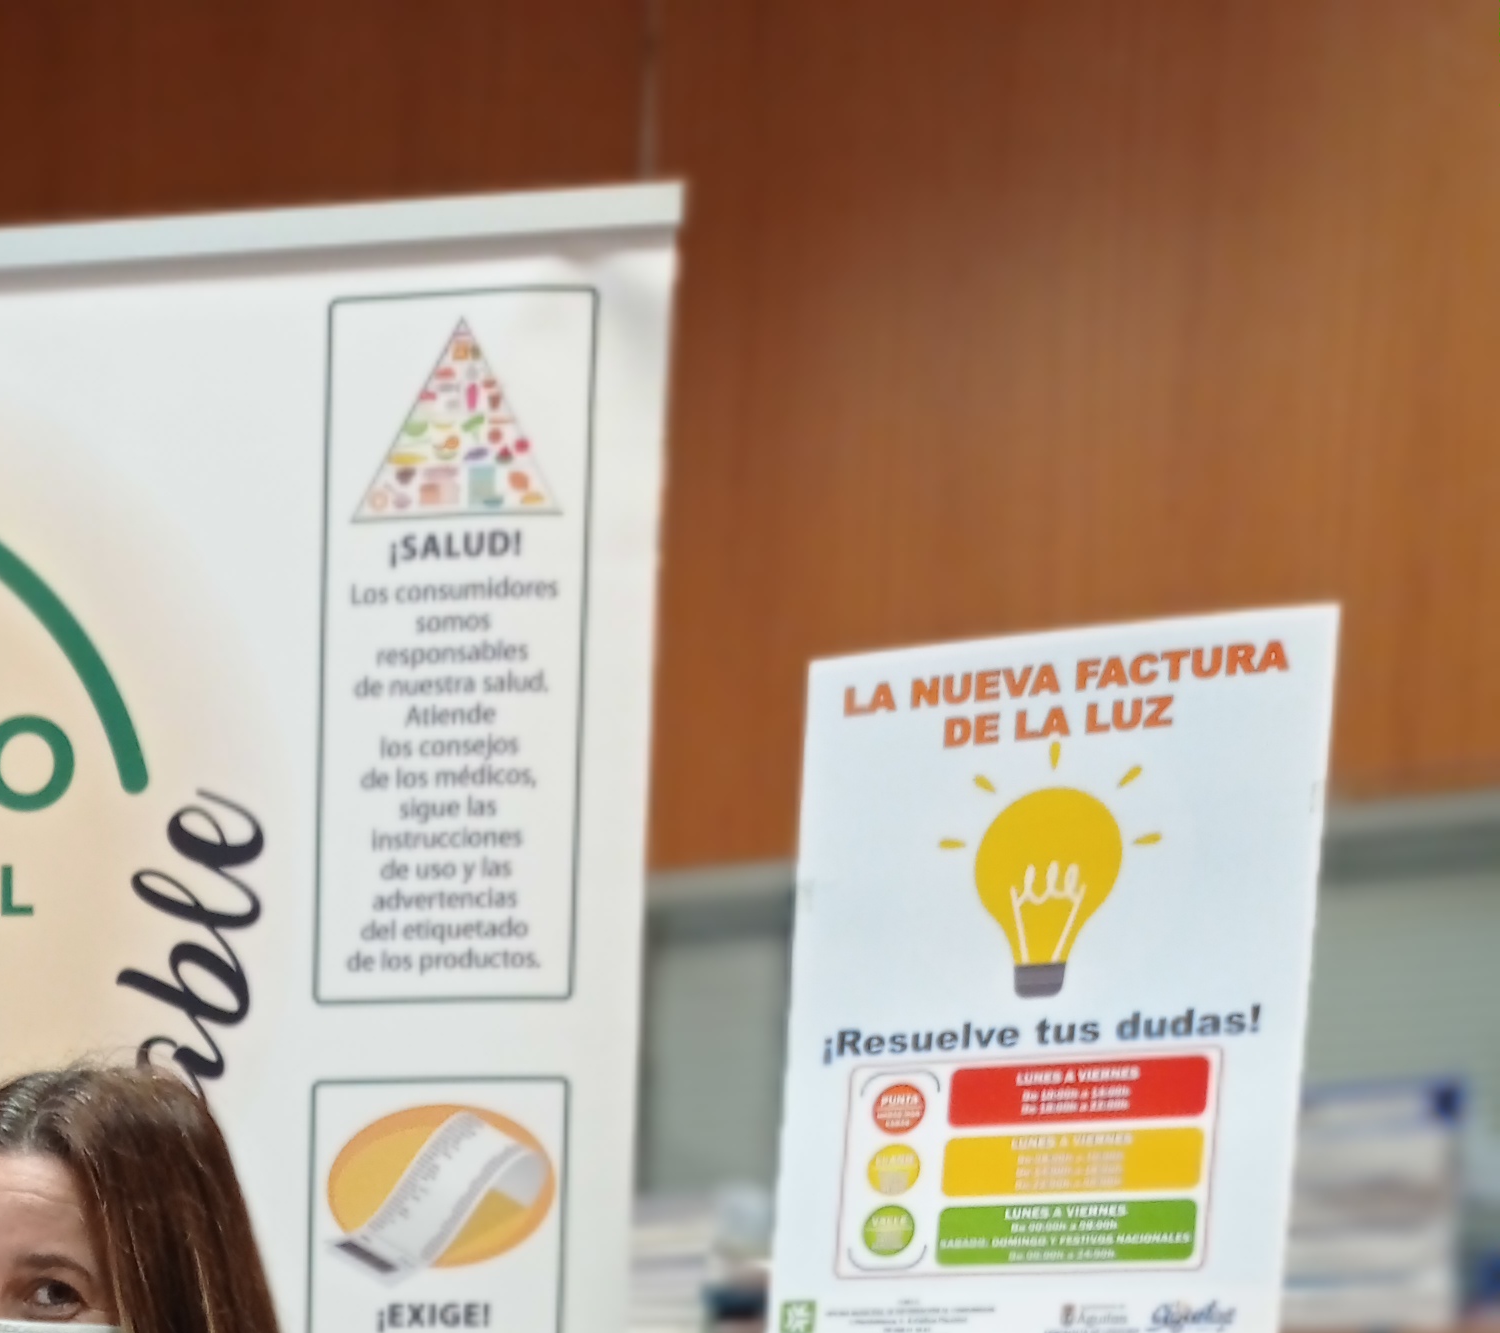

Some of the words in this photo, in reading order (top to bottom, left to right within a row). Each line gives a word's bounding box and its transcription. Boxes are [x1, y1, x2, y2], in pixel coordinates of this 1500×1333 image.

[390, 529, 521, 568] ¡SALUD!
[350, 584, 389, 606] Los
[394, 576, 559, 604] consumidores
[416, 613, 491, 633] somos
[376, 640, 529, 669] responsables
[354, 676, 383, 698] de
[388, 676, 476, 696] nuestra
[483, 670, 548, 693] salud.
[844, 682, 896, 716] LA
[911, 663, 1060, 708] NUEVA
[1076, 640, 1289, 691] FACTURA
[405, 703, 496, 726] Atiende
[944, 713, 1000, 748] DE
[1015, 706, 1070, 741] LA
[1085, 695, 1174, 734] LUZ
[380, 737, 413, 758] los
[418, 733, 520, 762] consejos
[360, 768, 389, 790] de
[396, 767, 429, 789] los
[435, 764, 536, 788] médicos,
[400, 798, 461, 824] sigue
[467, 795, 497, 817] las
[371, 827, 523, 851] instrucciones
[380, 859, 409, 880] de
[416, 862, 457, 880] uso
[463, 862, 476, 884] y
[481, 857, 512, 877] las
[372, 887, 518, 911] advertencias
[360, 920, 396, 941] del
[402, 916, 529, 944] etiquetado
[347, 951, 375, 972] de
[380, 950, 413, 971] los
[419, 947, 541, 975] productos.
[824, 1022, 1019, 1064] ¡Resuelve
[1036, 1019, 1099, 1045] tus
[1116, 1004, 1261, 1040] dudas!
[1016, 1071, 1063, 1085] LUNES
[1064, 1070, 1075, 1083] A
[1078, 1067, 1139, 1082] VIERNES
[1004, 1206, 1051, 1220] LUNES
[1065, 1204, 1128, 1218] VIERNES
[377, 1302, 490, 1333] ¡EXIGE!
